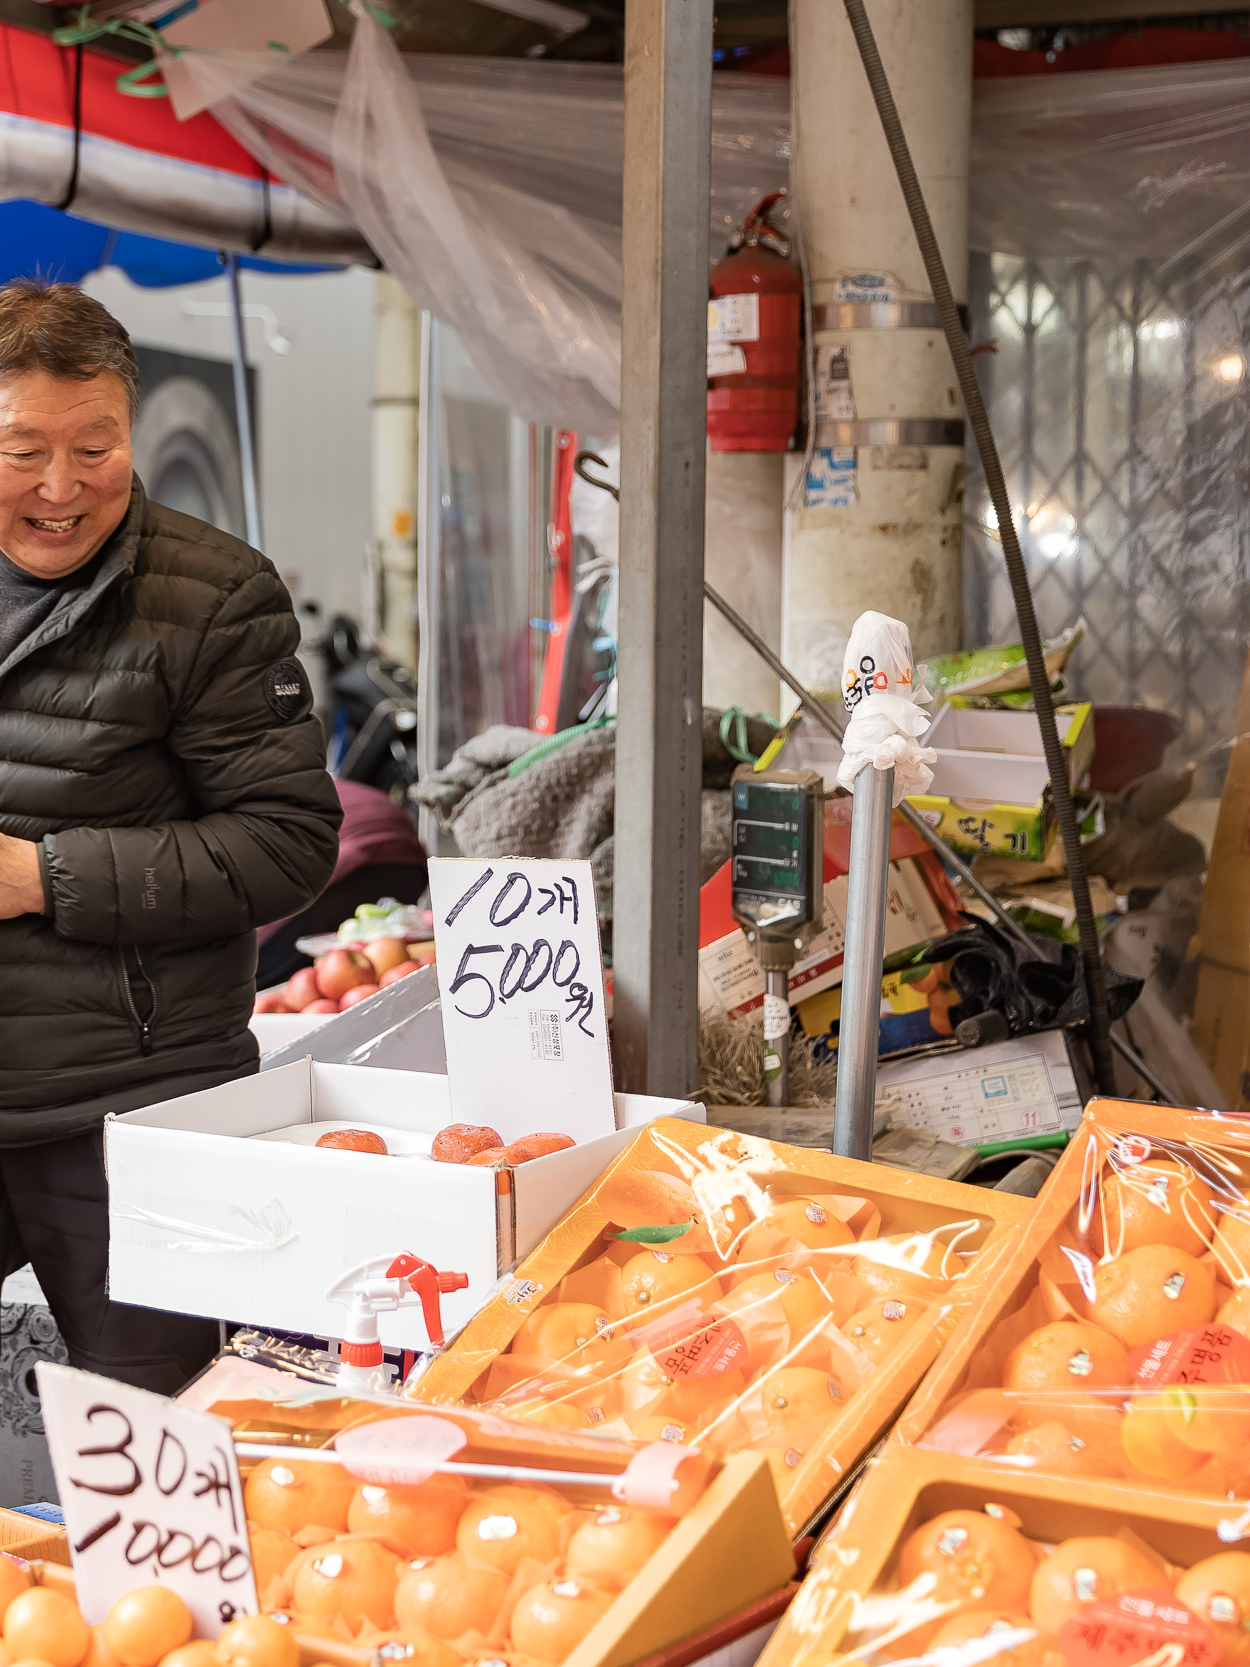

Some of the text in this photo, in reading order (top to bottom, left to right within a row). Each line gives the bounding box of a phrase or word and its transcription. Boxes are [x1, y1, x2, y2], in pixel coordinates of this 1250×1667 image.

[444, 867, 579, 927] 10개
[1135, 1340, 1173, 1379] 선물세트
[70, 1403, 238, 1535] 30개
